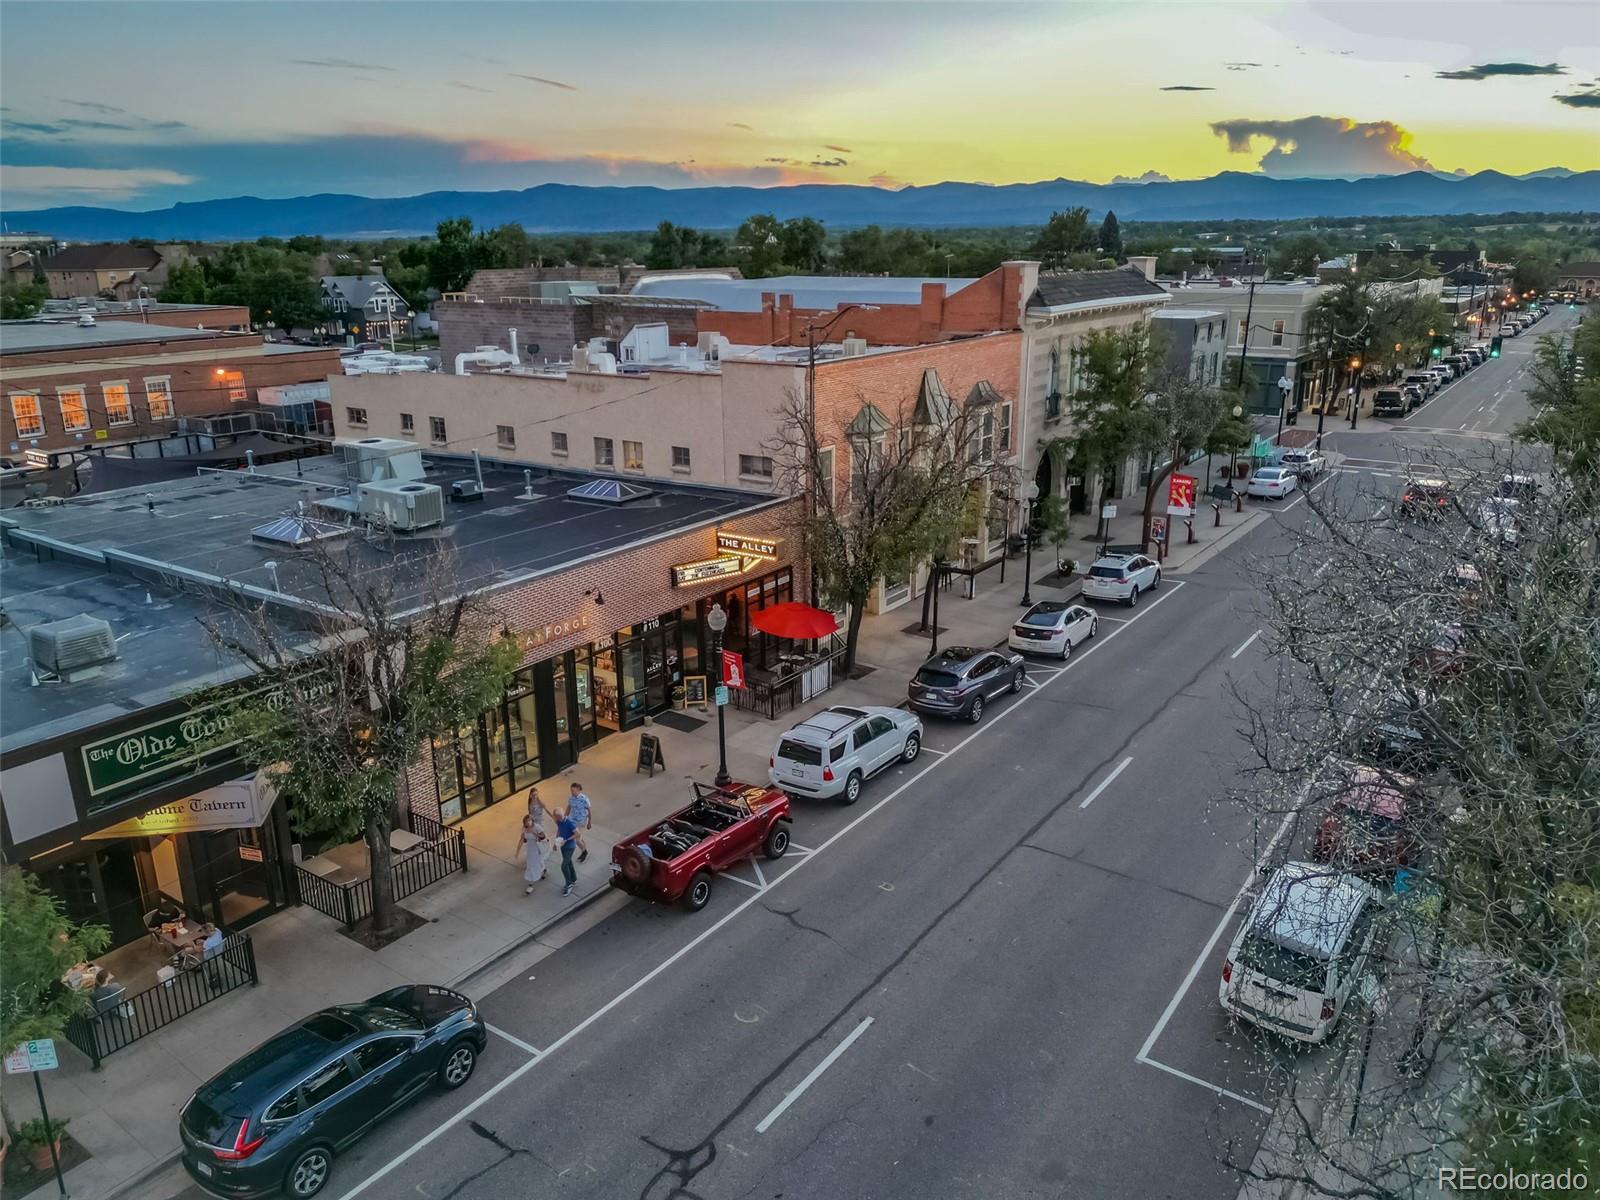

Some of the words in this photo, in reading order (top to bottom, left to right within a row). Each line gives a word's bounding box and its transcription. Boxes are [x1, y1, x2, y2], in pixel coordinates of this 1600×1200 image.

[720, 538, 739, 548] THE
[741, 542, 774, 553] ALLEY
[88, 747, 114, 762] The
[116, 734, 177, 764] Olde
[179, 714, 237, 743] Tow
[138, 804, 185, 819] owne
[188, 798, 246, 812] Tavern
